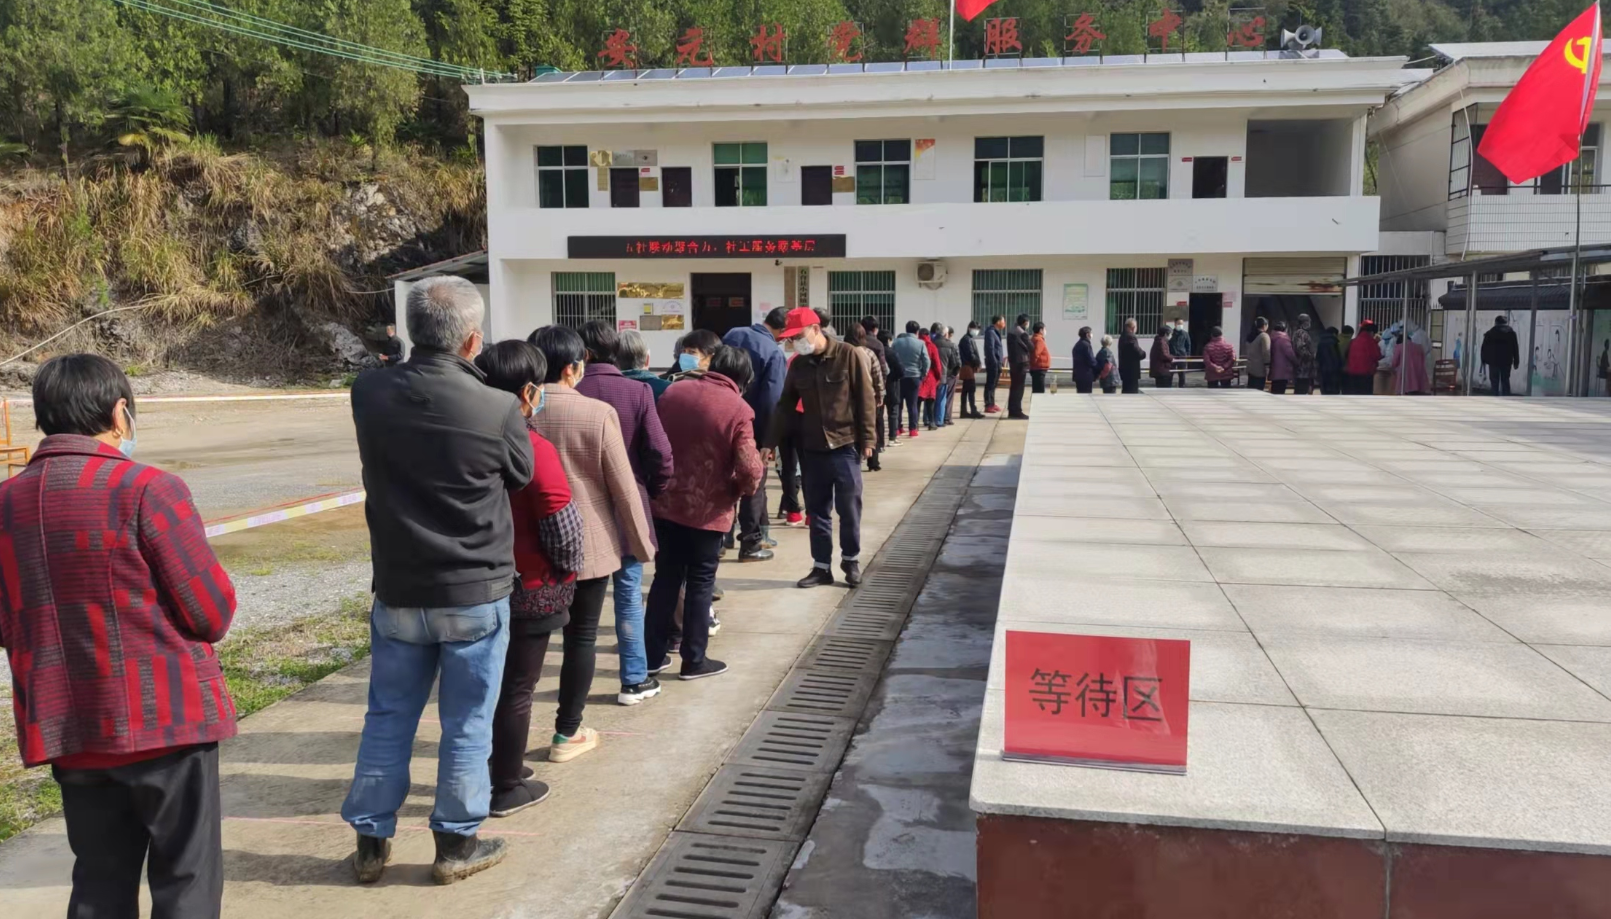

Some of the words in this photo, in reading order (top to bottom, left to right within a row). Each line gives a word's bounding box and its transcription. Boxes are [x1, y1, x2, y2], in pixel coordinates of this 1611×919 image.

[598, 7, 1265, 67] 安元村党群服务中心
[1028, 667, 1163, 722] 等待区
